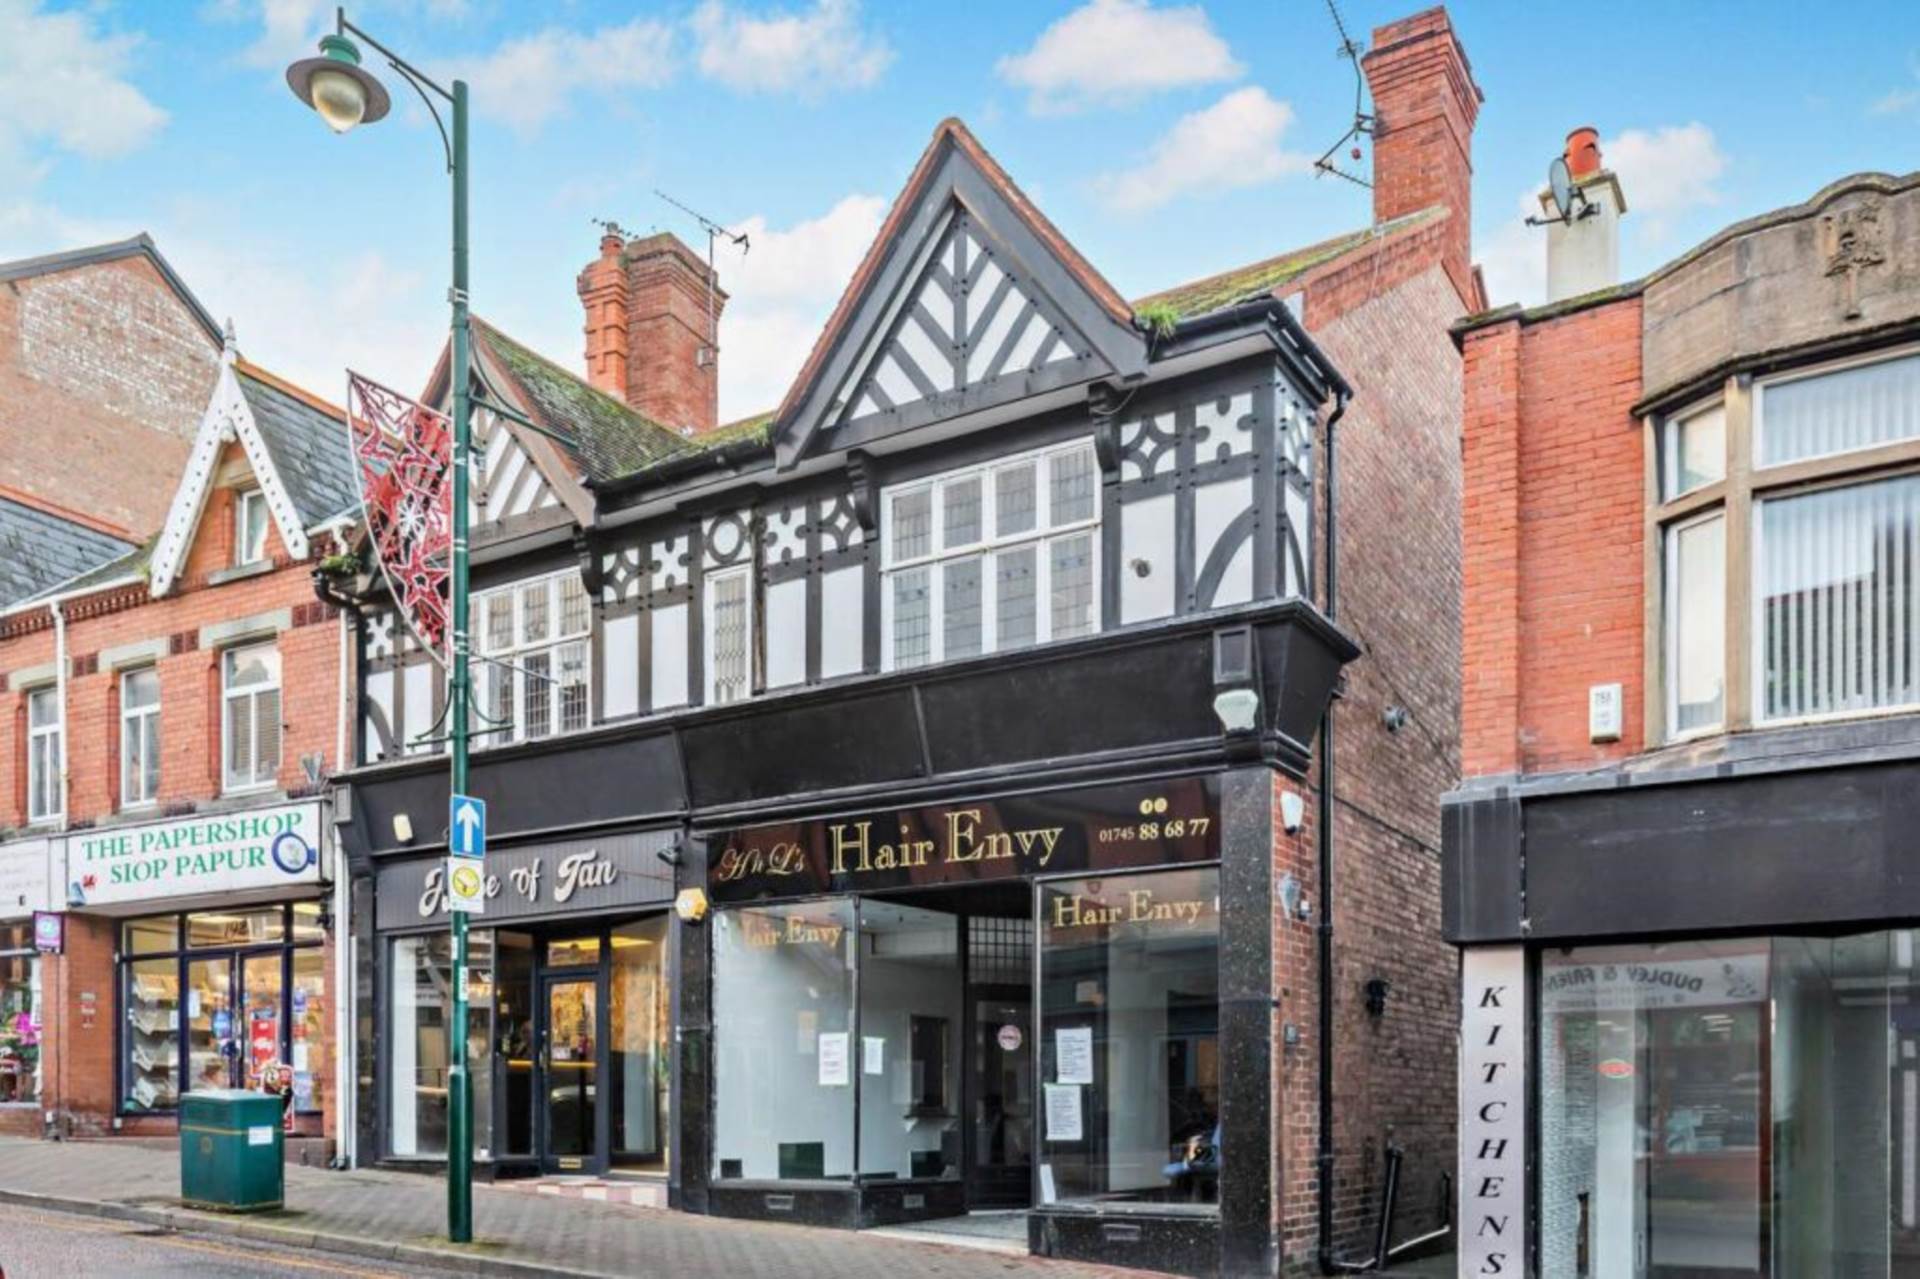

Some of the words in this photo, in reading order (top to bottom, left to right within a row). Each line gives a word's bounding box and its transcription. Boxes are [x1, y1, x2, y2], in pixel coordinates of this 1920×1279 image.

[81, 836, 132, 861] THE
[141, 812, 303, 851] PAPERSHOP
[829, 820, 934, 875] Hair
[944, 809, 1064, 866] Envy
[1099, 827, 1135, 842] 01745
[1139, 822, 1159, 840] 88
[1164, 820, 1184, 838] 68
[1188, 818, 1210, 836] 77
[110, 857, 168, 884] SIOP
[176, 846, 266, 877] PAPUR
[509, 857, 541, 901] of
[554, 849, 617, 902] Tan
[784, 911, 842, 948] Envy
[1052, 895, 1122, 928] Hair
[1129, 889, 1203, 924] Envy
[1478, 985, 1508, 1275] KITCHENS
